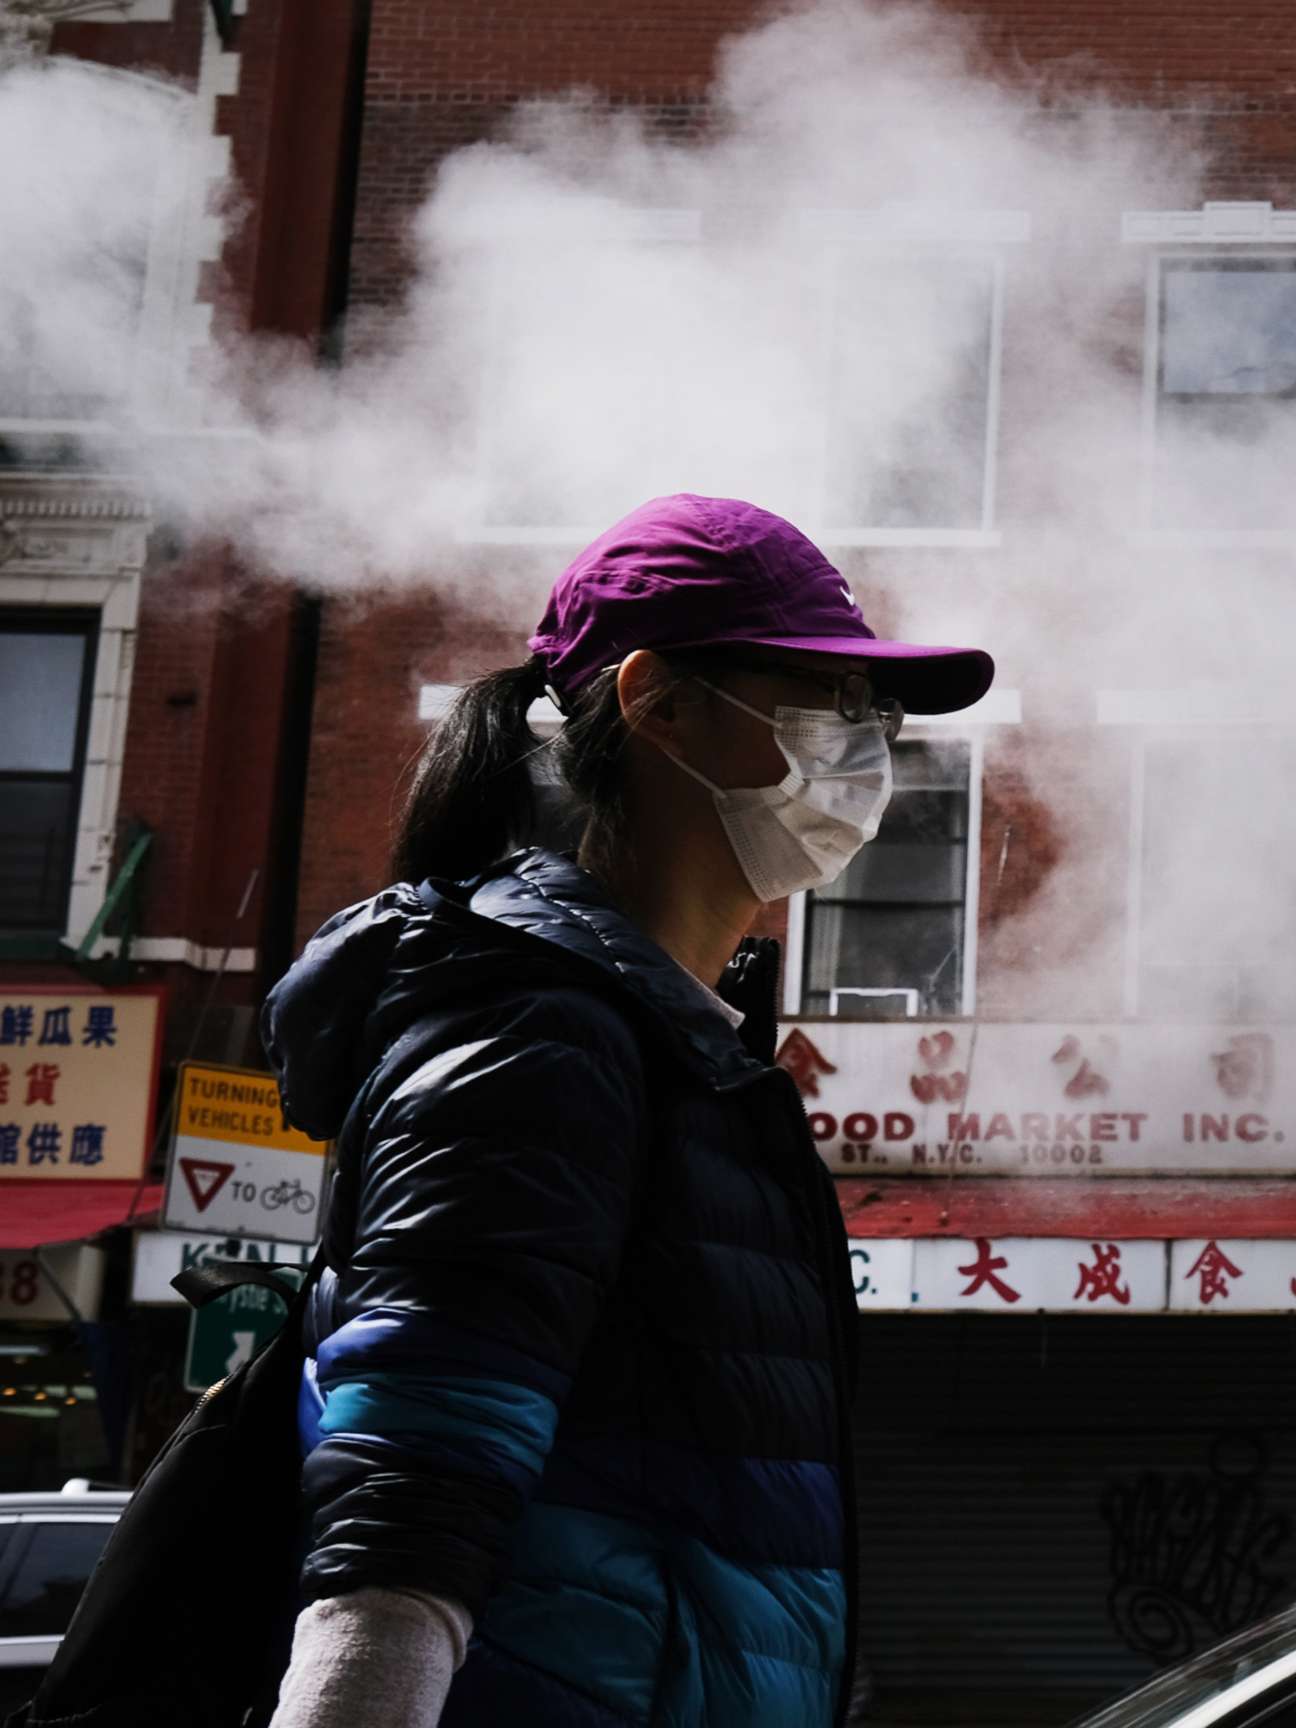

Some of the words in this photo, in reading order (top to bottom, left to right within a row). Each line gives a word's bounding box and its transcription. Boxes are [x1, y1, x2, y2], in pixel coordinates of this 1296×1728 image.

[190, 1077, 279, 1108] TURNING
[187, 1107, 274, 1137] VEHICLES
[947, 1112, 1148, 1143] MARKET
[1182, 1112, 1285, 1143] INC.
[1019, 1143, 1103, 1164] 10002
[231, 1181, 256, 1202] TO
